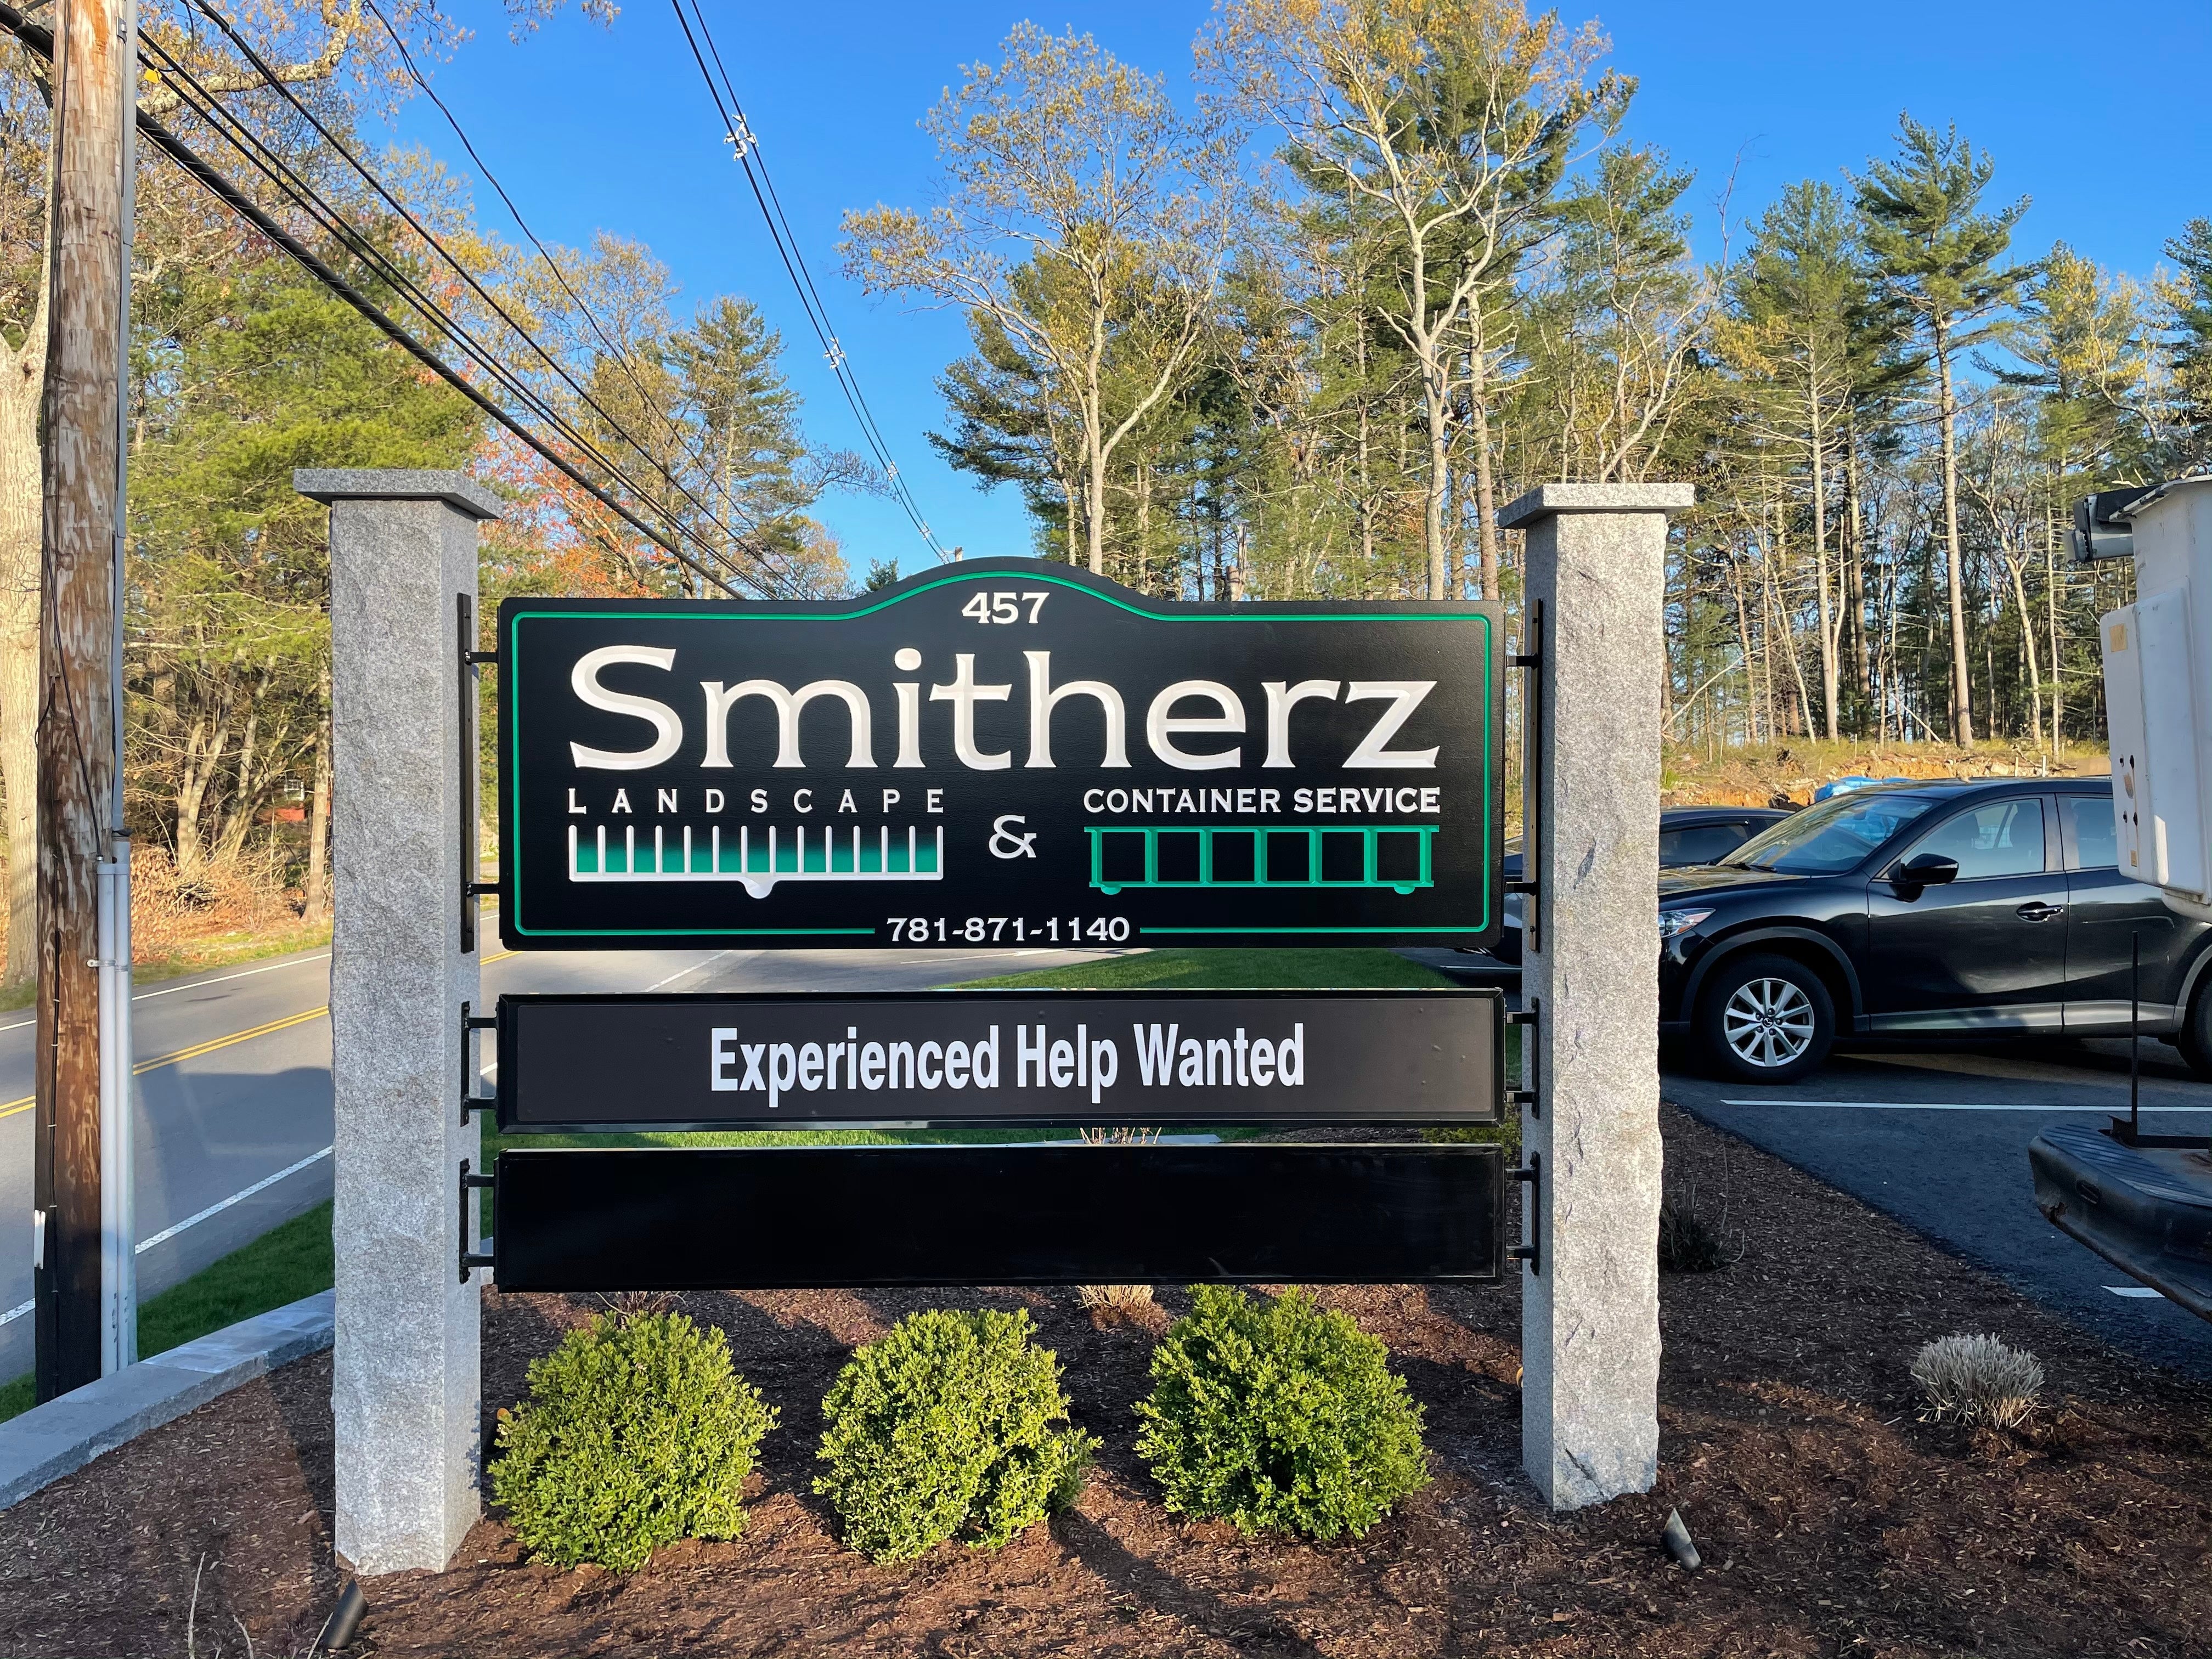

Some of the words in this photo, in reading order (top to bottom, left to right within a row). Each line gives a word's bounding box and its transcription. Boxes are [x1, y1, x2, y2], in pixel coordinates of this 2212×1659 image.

[961, 591, 1051, 625] 457
[569, 645, 1440, 770] Smitherz
[567, 787, 944, 815] LANDSCAPE
[1083, 787, 1282, 814] CONTAINER
[1293, 786, 1441, 814] SERVICE
[988, 814, 1037, 860] &
[886, 916, 1130, 943] 781-871-1140
[710, 1024, 1000, 1108] Experienced
[1017, 1023, 1119, 1104] Help
[1132, 1022, 1305, 1087] Wanted
